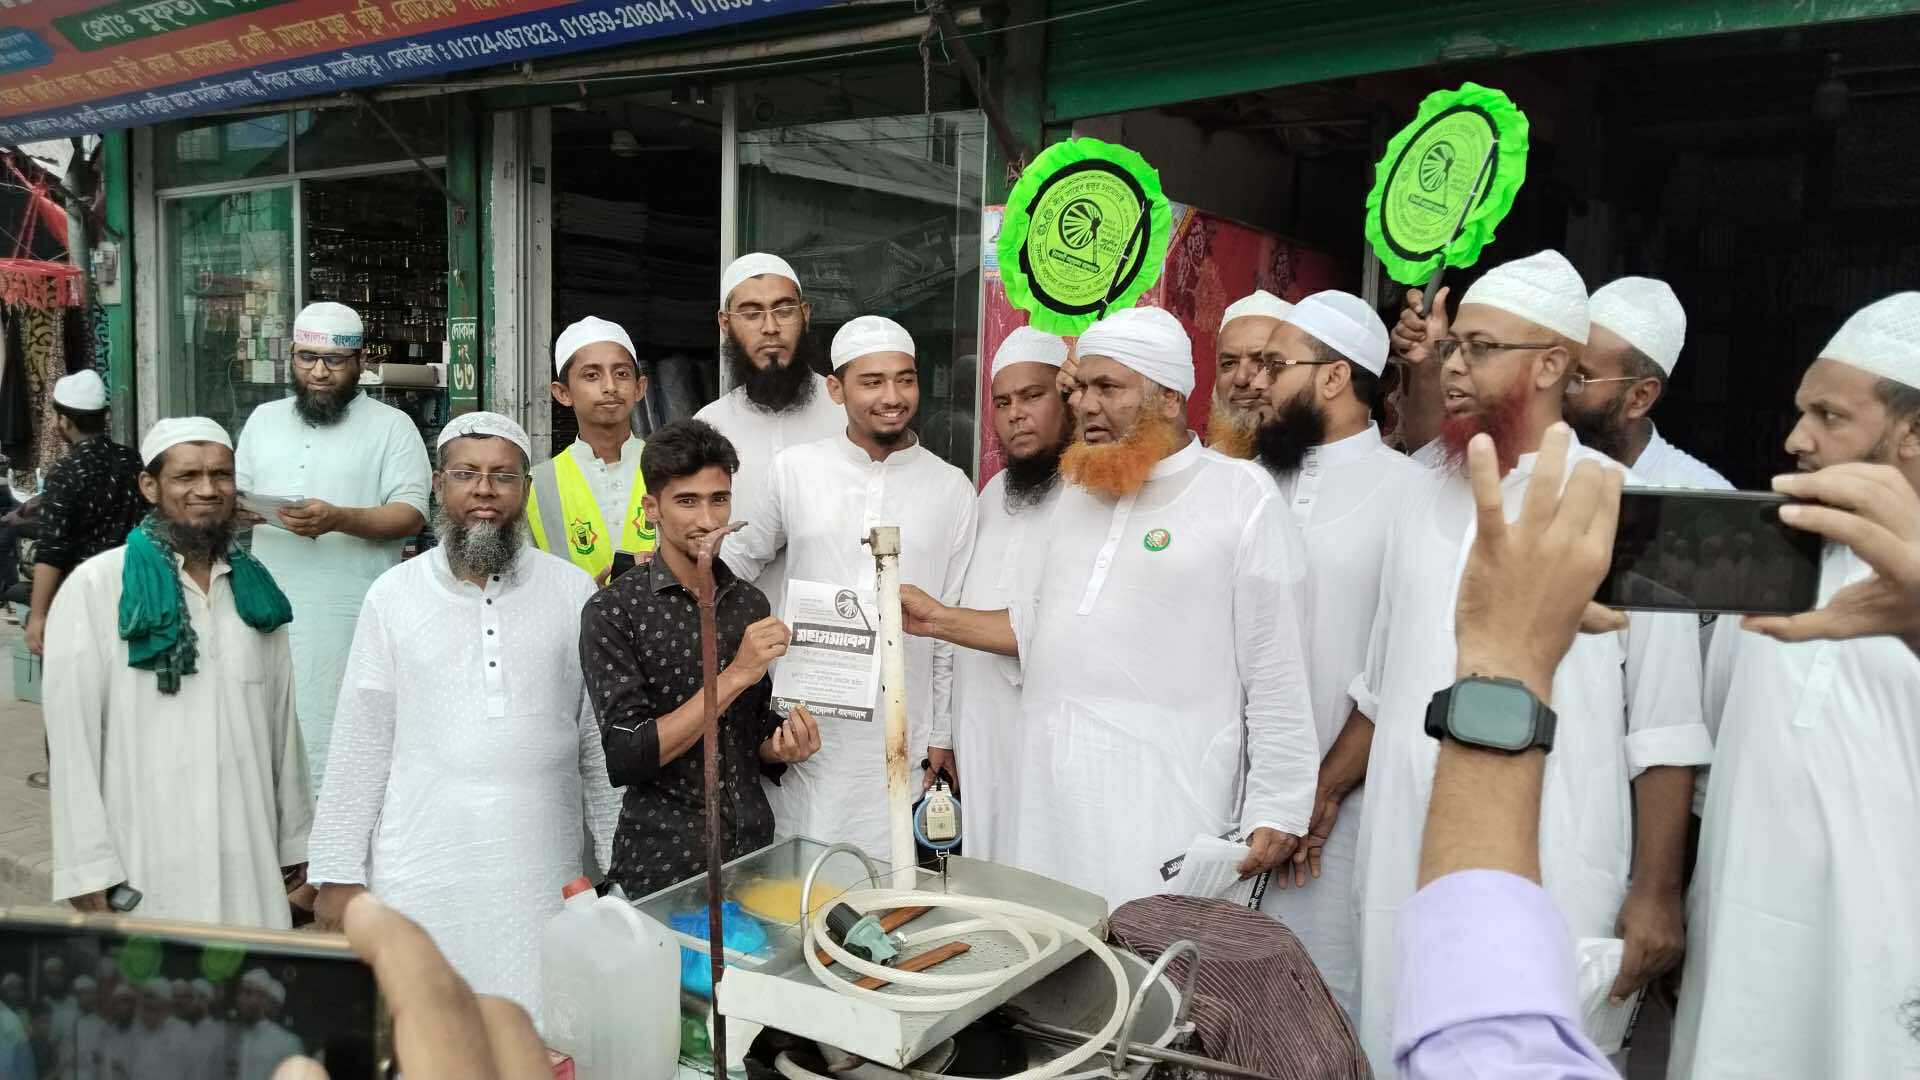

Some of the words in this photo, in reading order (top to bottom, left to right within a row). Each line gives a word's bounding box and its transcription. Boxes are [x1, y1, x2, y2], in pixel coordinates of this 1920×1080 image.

[387, 42, 442, 69] মোবাইল
[447, 22, 565, 60] 01724-067823,
[560, 0, 694, 41] 01959-208041,
[451, 322, 476, 342] দোকান
[796, 628, 871, 650] মহাসমাবেশ
